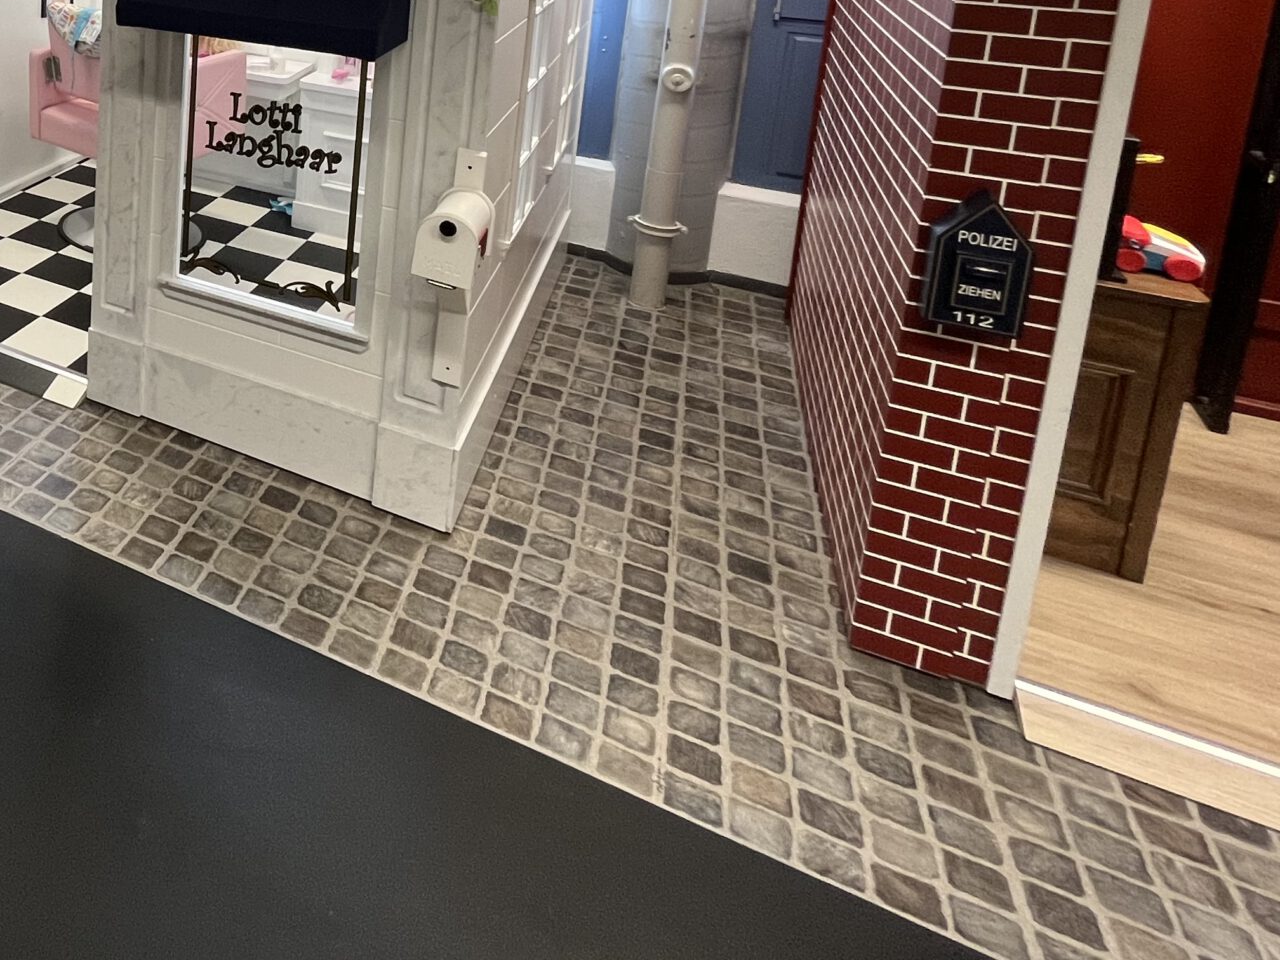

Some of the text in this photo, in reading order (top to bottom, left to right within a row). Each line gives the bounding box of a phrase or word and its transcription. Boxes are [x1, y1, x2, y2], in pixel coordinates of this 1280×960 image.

[229, 91, 303, 134] Lotti
[205, 120, 342, 174] Langhaar
[957, 230, 1018, 252] POLIZEI
[957, 283, 1001, 301] ZIEHEN
[952, 311, 995, 329] 112
